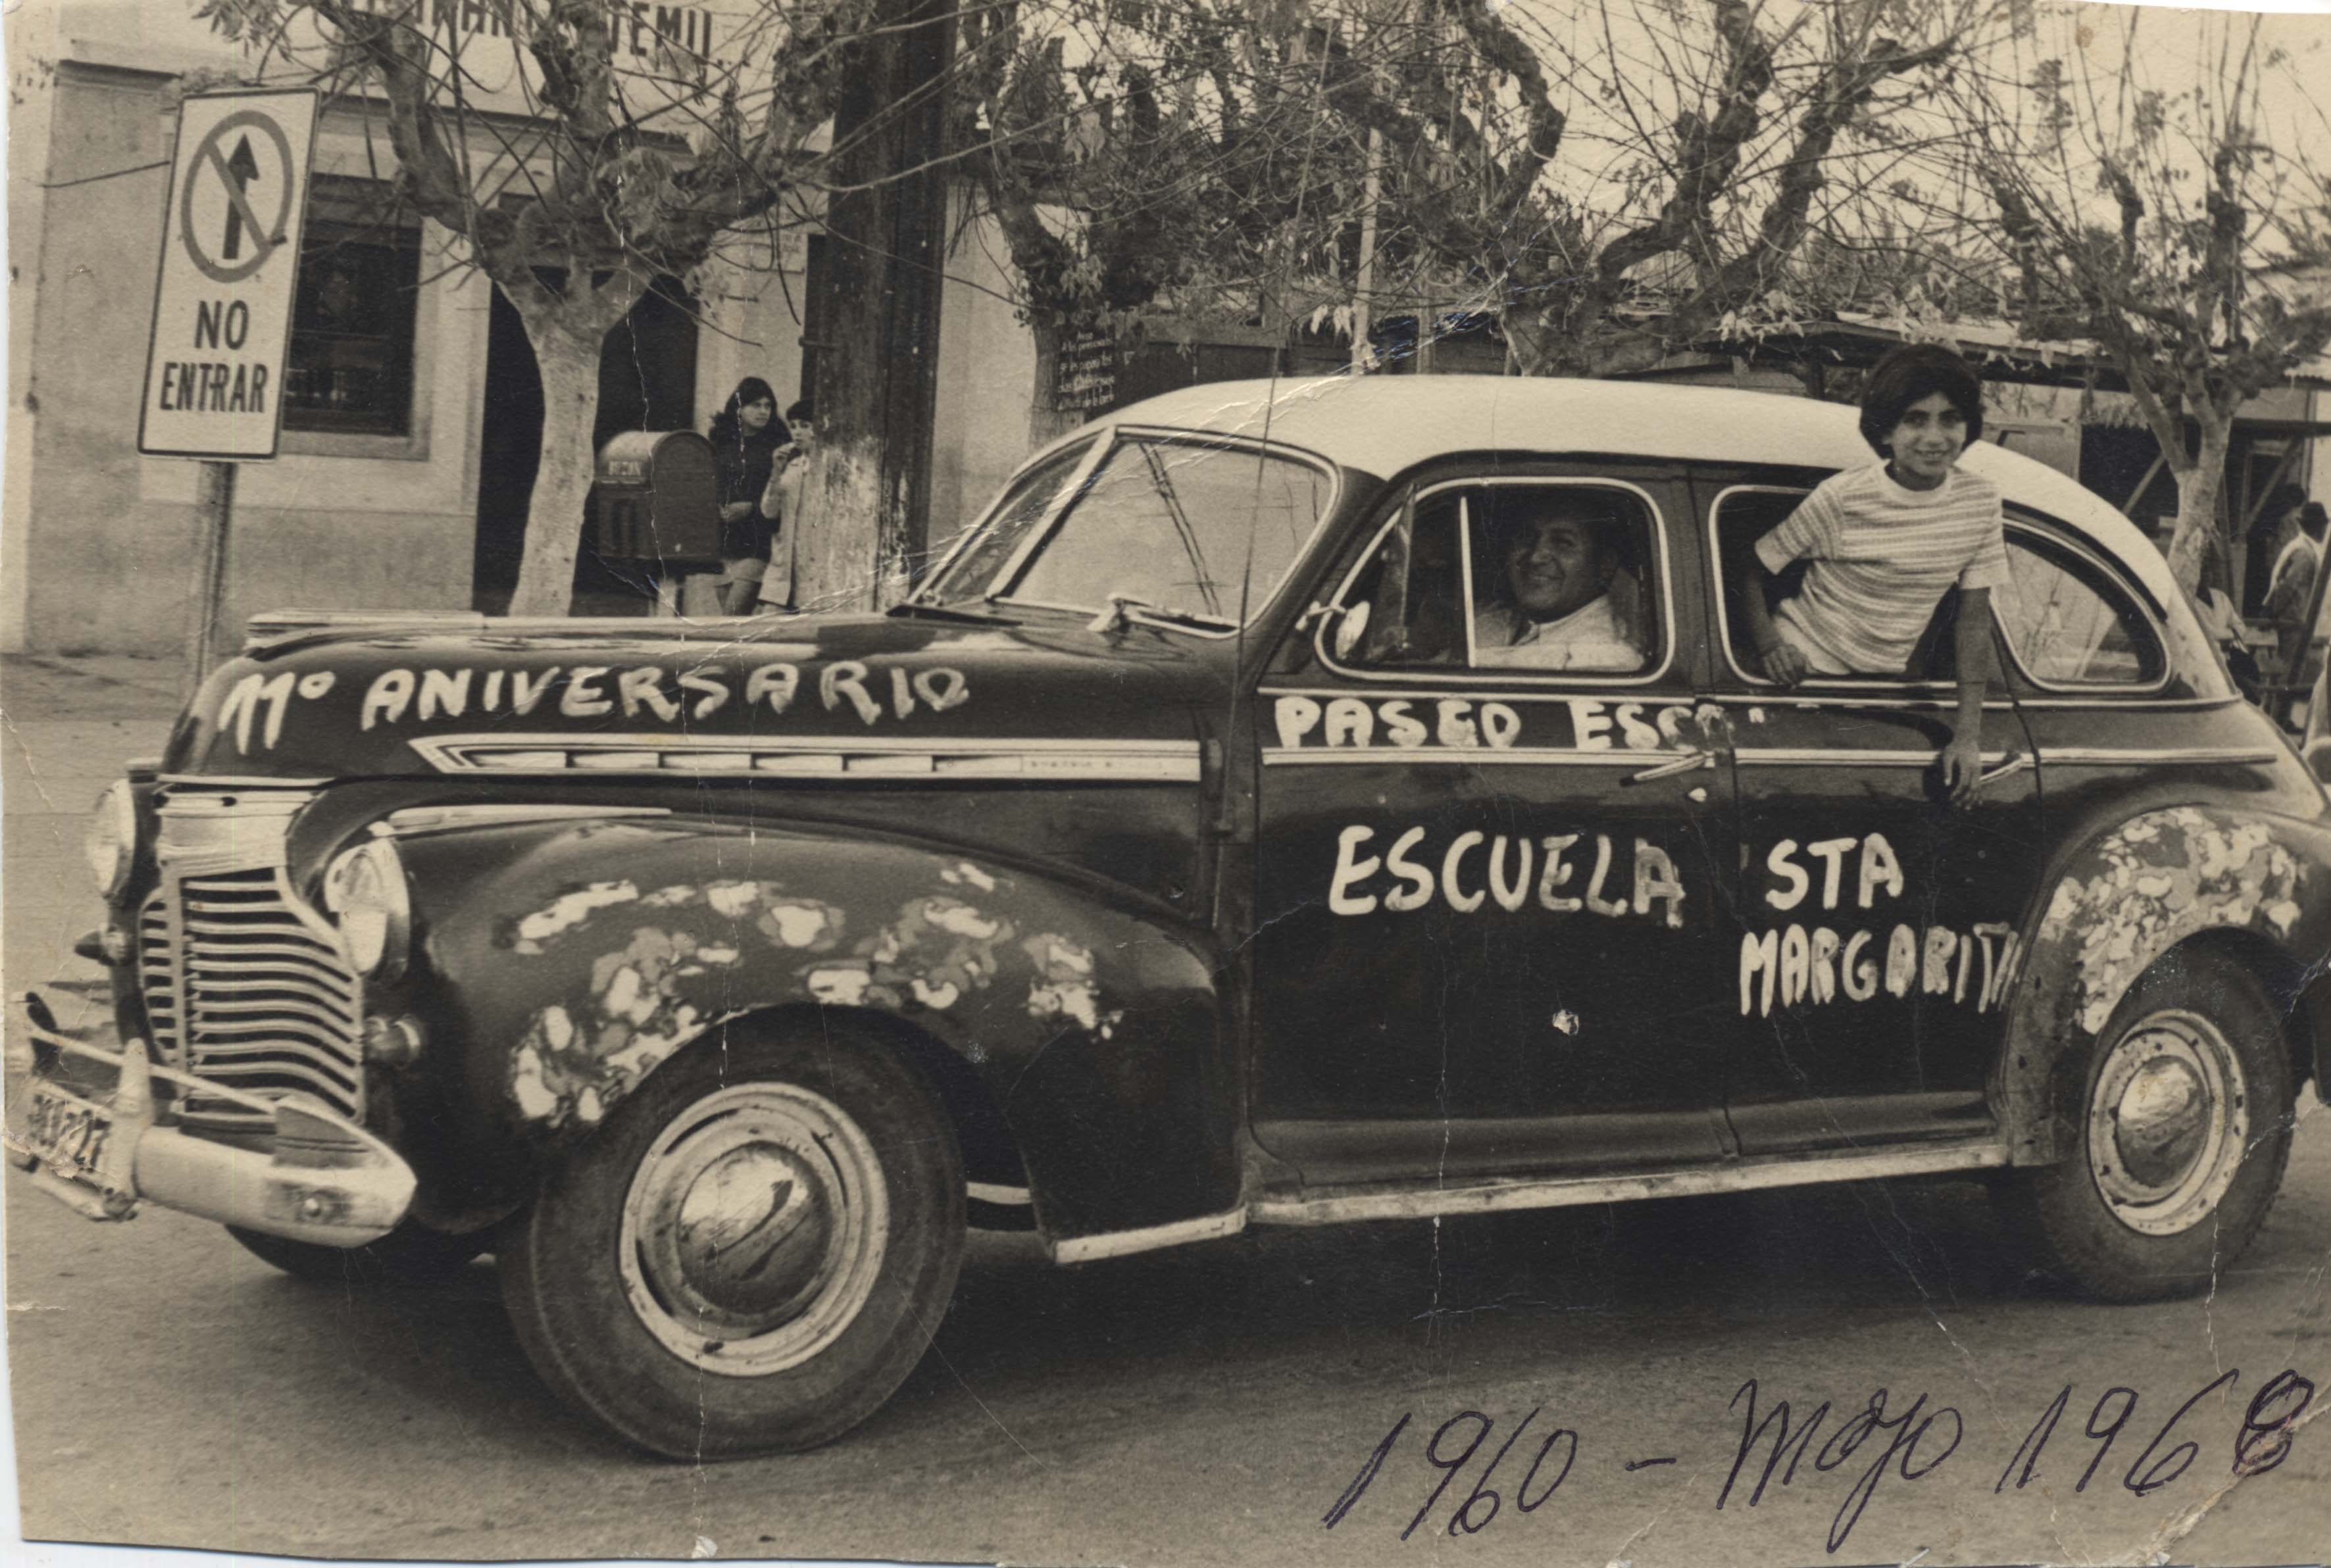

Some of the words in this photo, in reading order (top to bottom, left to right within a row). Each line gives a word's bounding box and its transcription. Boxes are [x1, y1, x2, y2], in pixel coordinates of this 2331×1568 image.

[194, 299, 249, 351] NO
[160, 362, 268, 413] ENTRAR
[361, 660, 969, 731] ANIVERSARIO
[1274, 696, 1522, 748] PASEO
[1329, 824, 1686, 929] ESCUELA
[1766, 832, 1904, 910] STA
